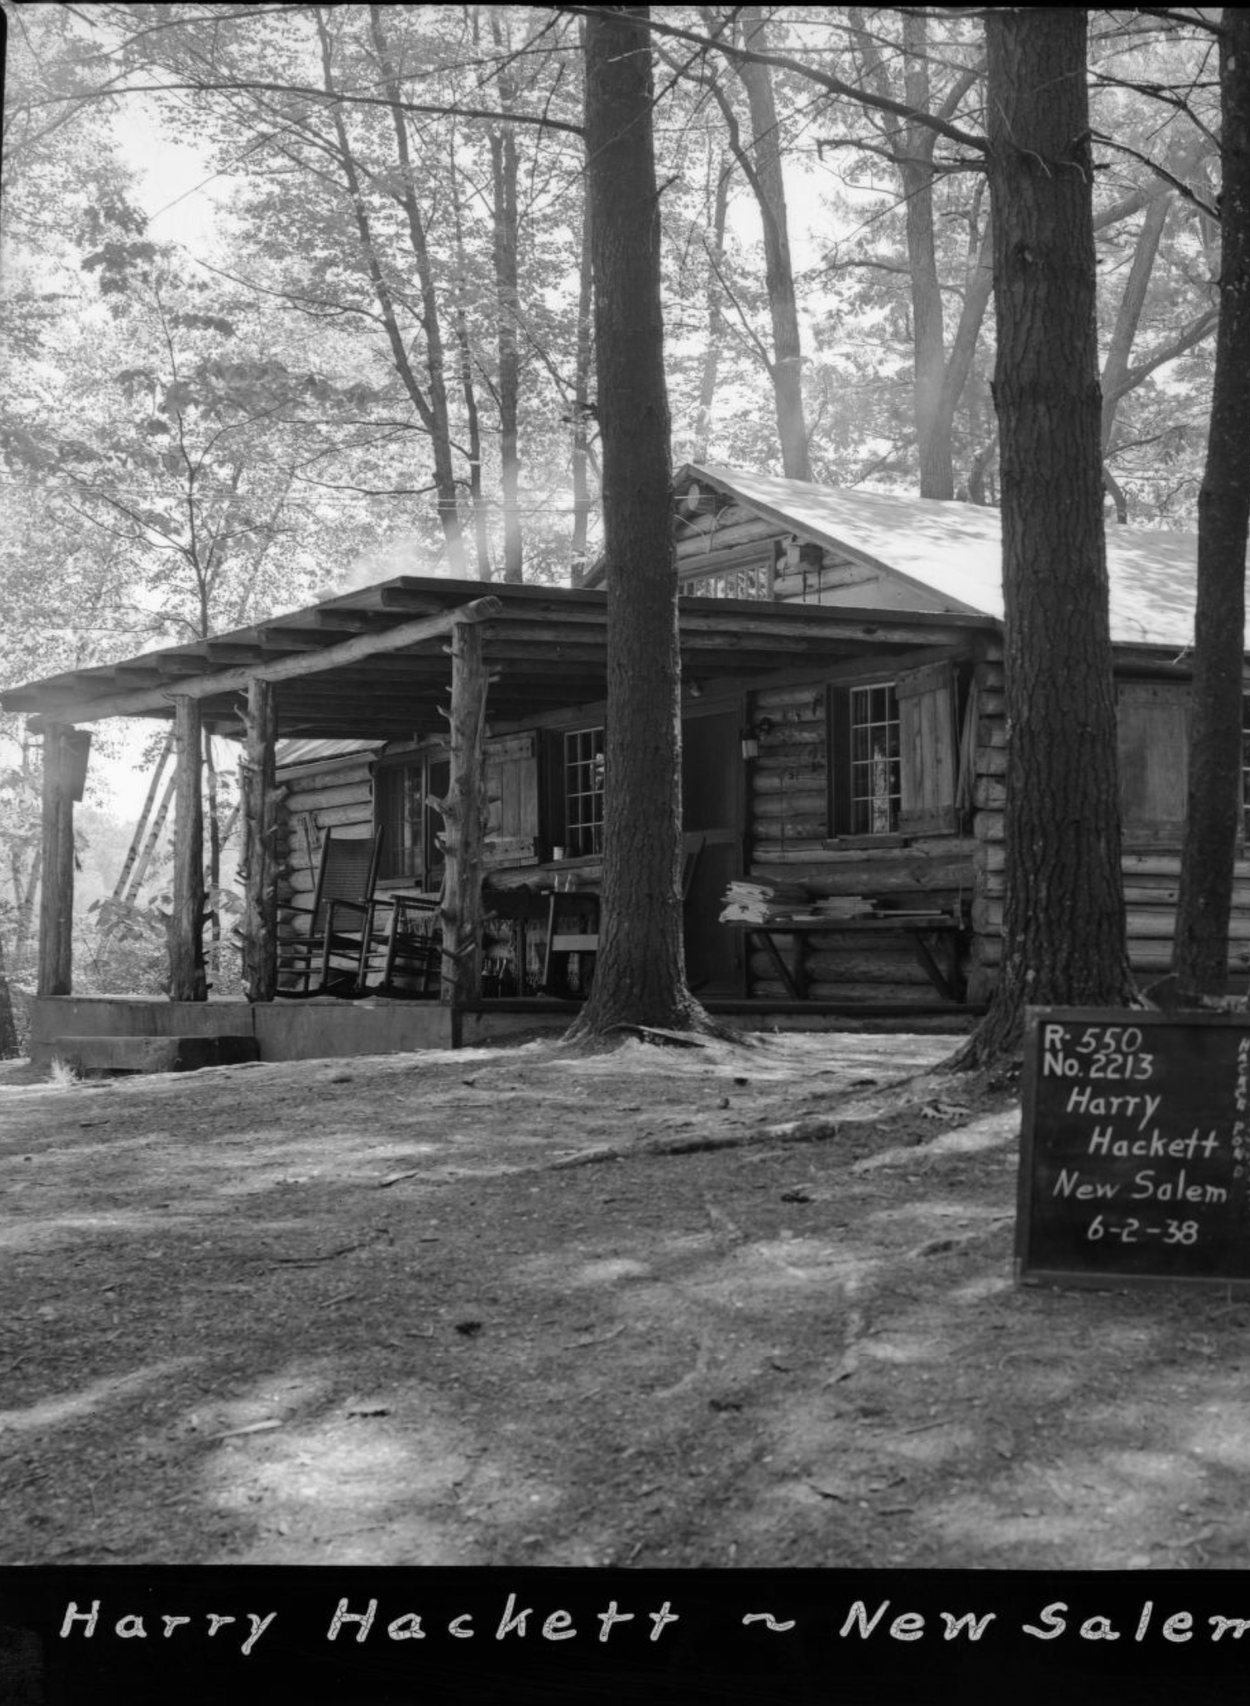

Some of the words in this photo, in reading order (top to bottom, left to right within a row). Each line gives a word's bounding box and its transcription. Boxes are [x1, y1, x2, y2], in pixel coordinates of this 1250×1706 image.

[1076, 1027, 1143, 1054] 550
[1043, 1051, 1084, 1077] No.
[1090, 1053, 1155, 1080] 2213
[1065, 1086, 1162, 1131] Harry
[1087, 1125, 1220, 1160] Hackett
[1052, 1168, 1120, 1200] New
[1130, 1169, 1228, 1203] Salem
[1086, 1214, 1199, 1245] 6-2-38
